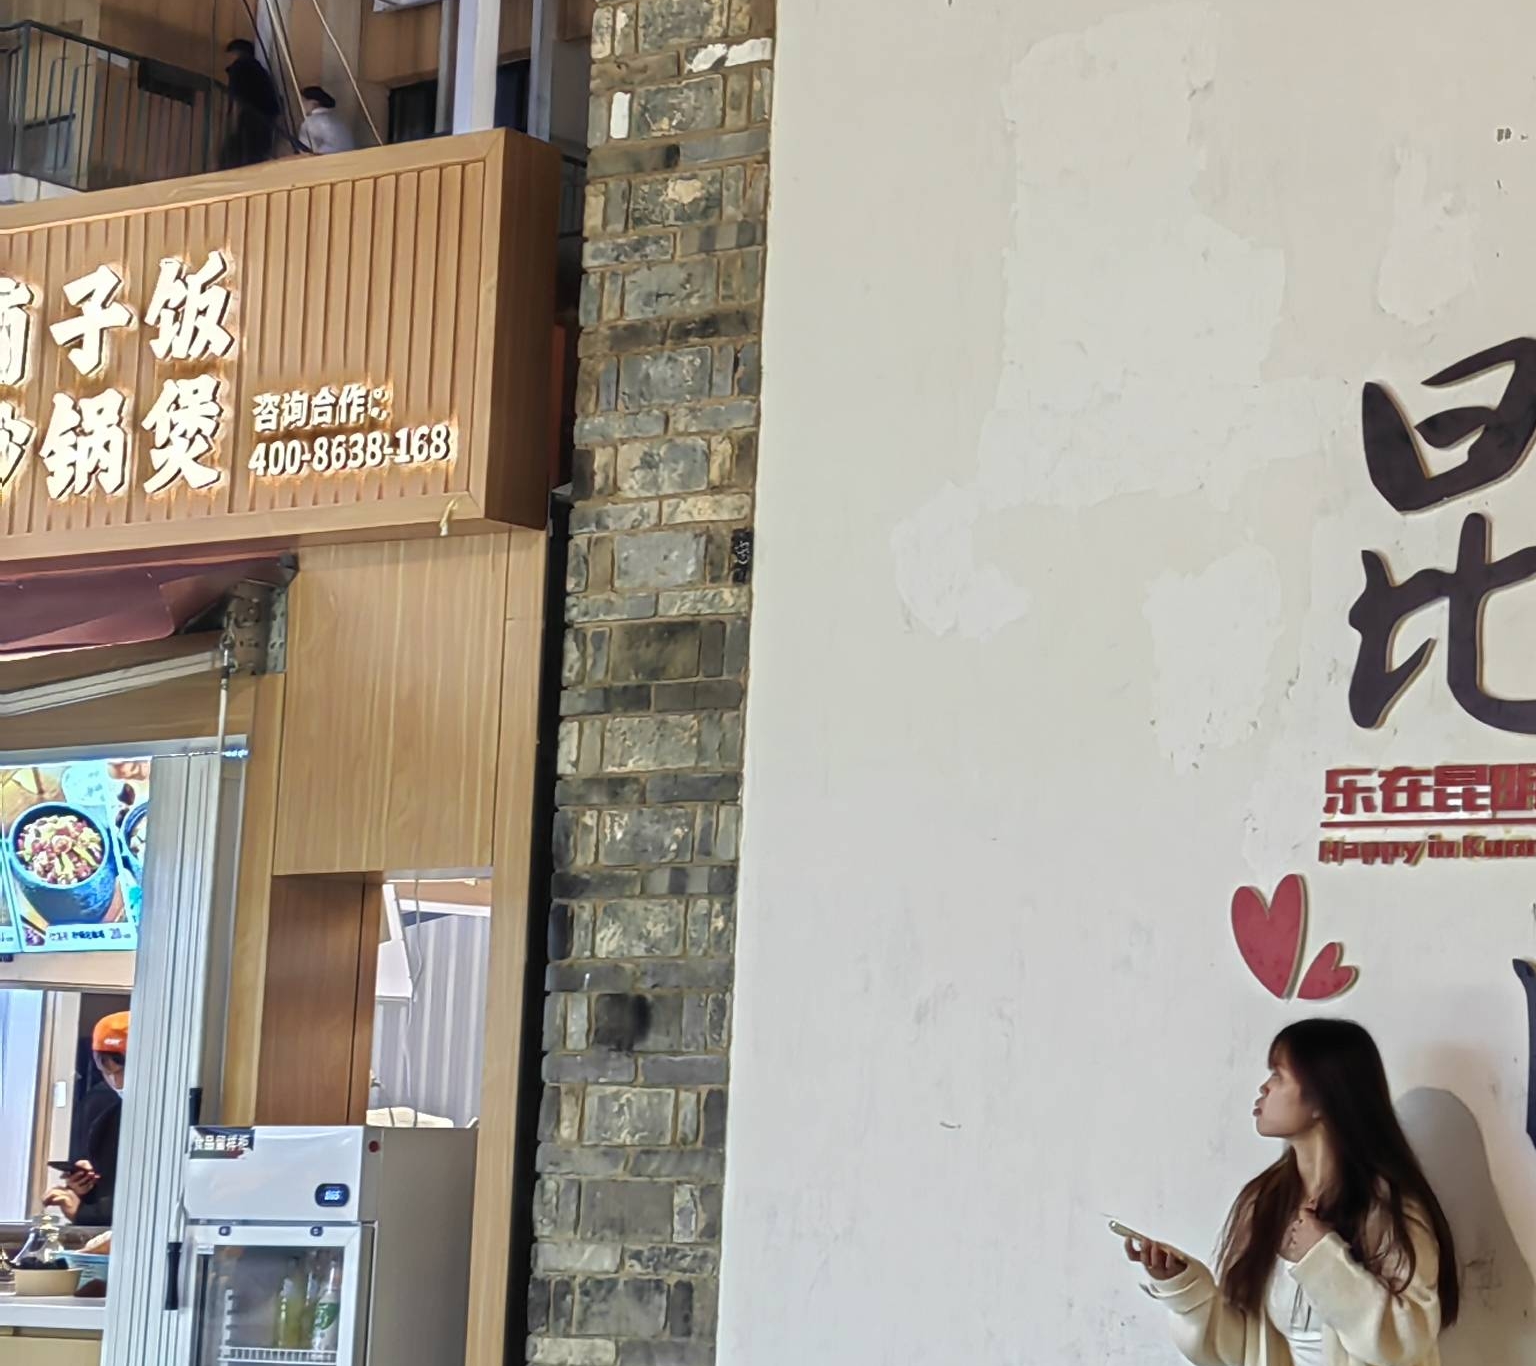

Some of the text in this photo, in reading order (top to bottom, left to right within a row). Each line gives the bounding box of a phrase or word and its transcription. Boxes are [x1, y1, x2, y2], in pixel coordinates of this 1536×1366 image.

[248, 422, 453, 478] 400-8638-168
[1318, 836, 1425, 866] Happy
[1427, 834, 1461, 858] in
